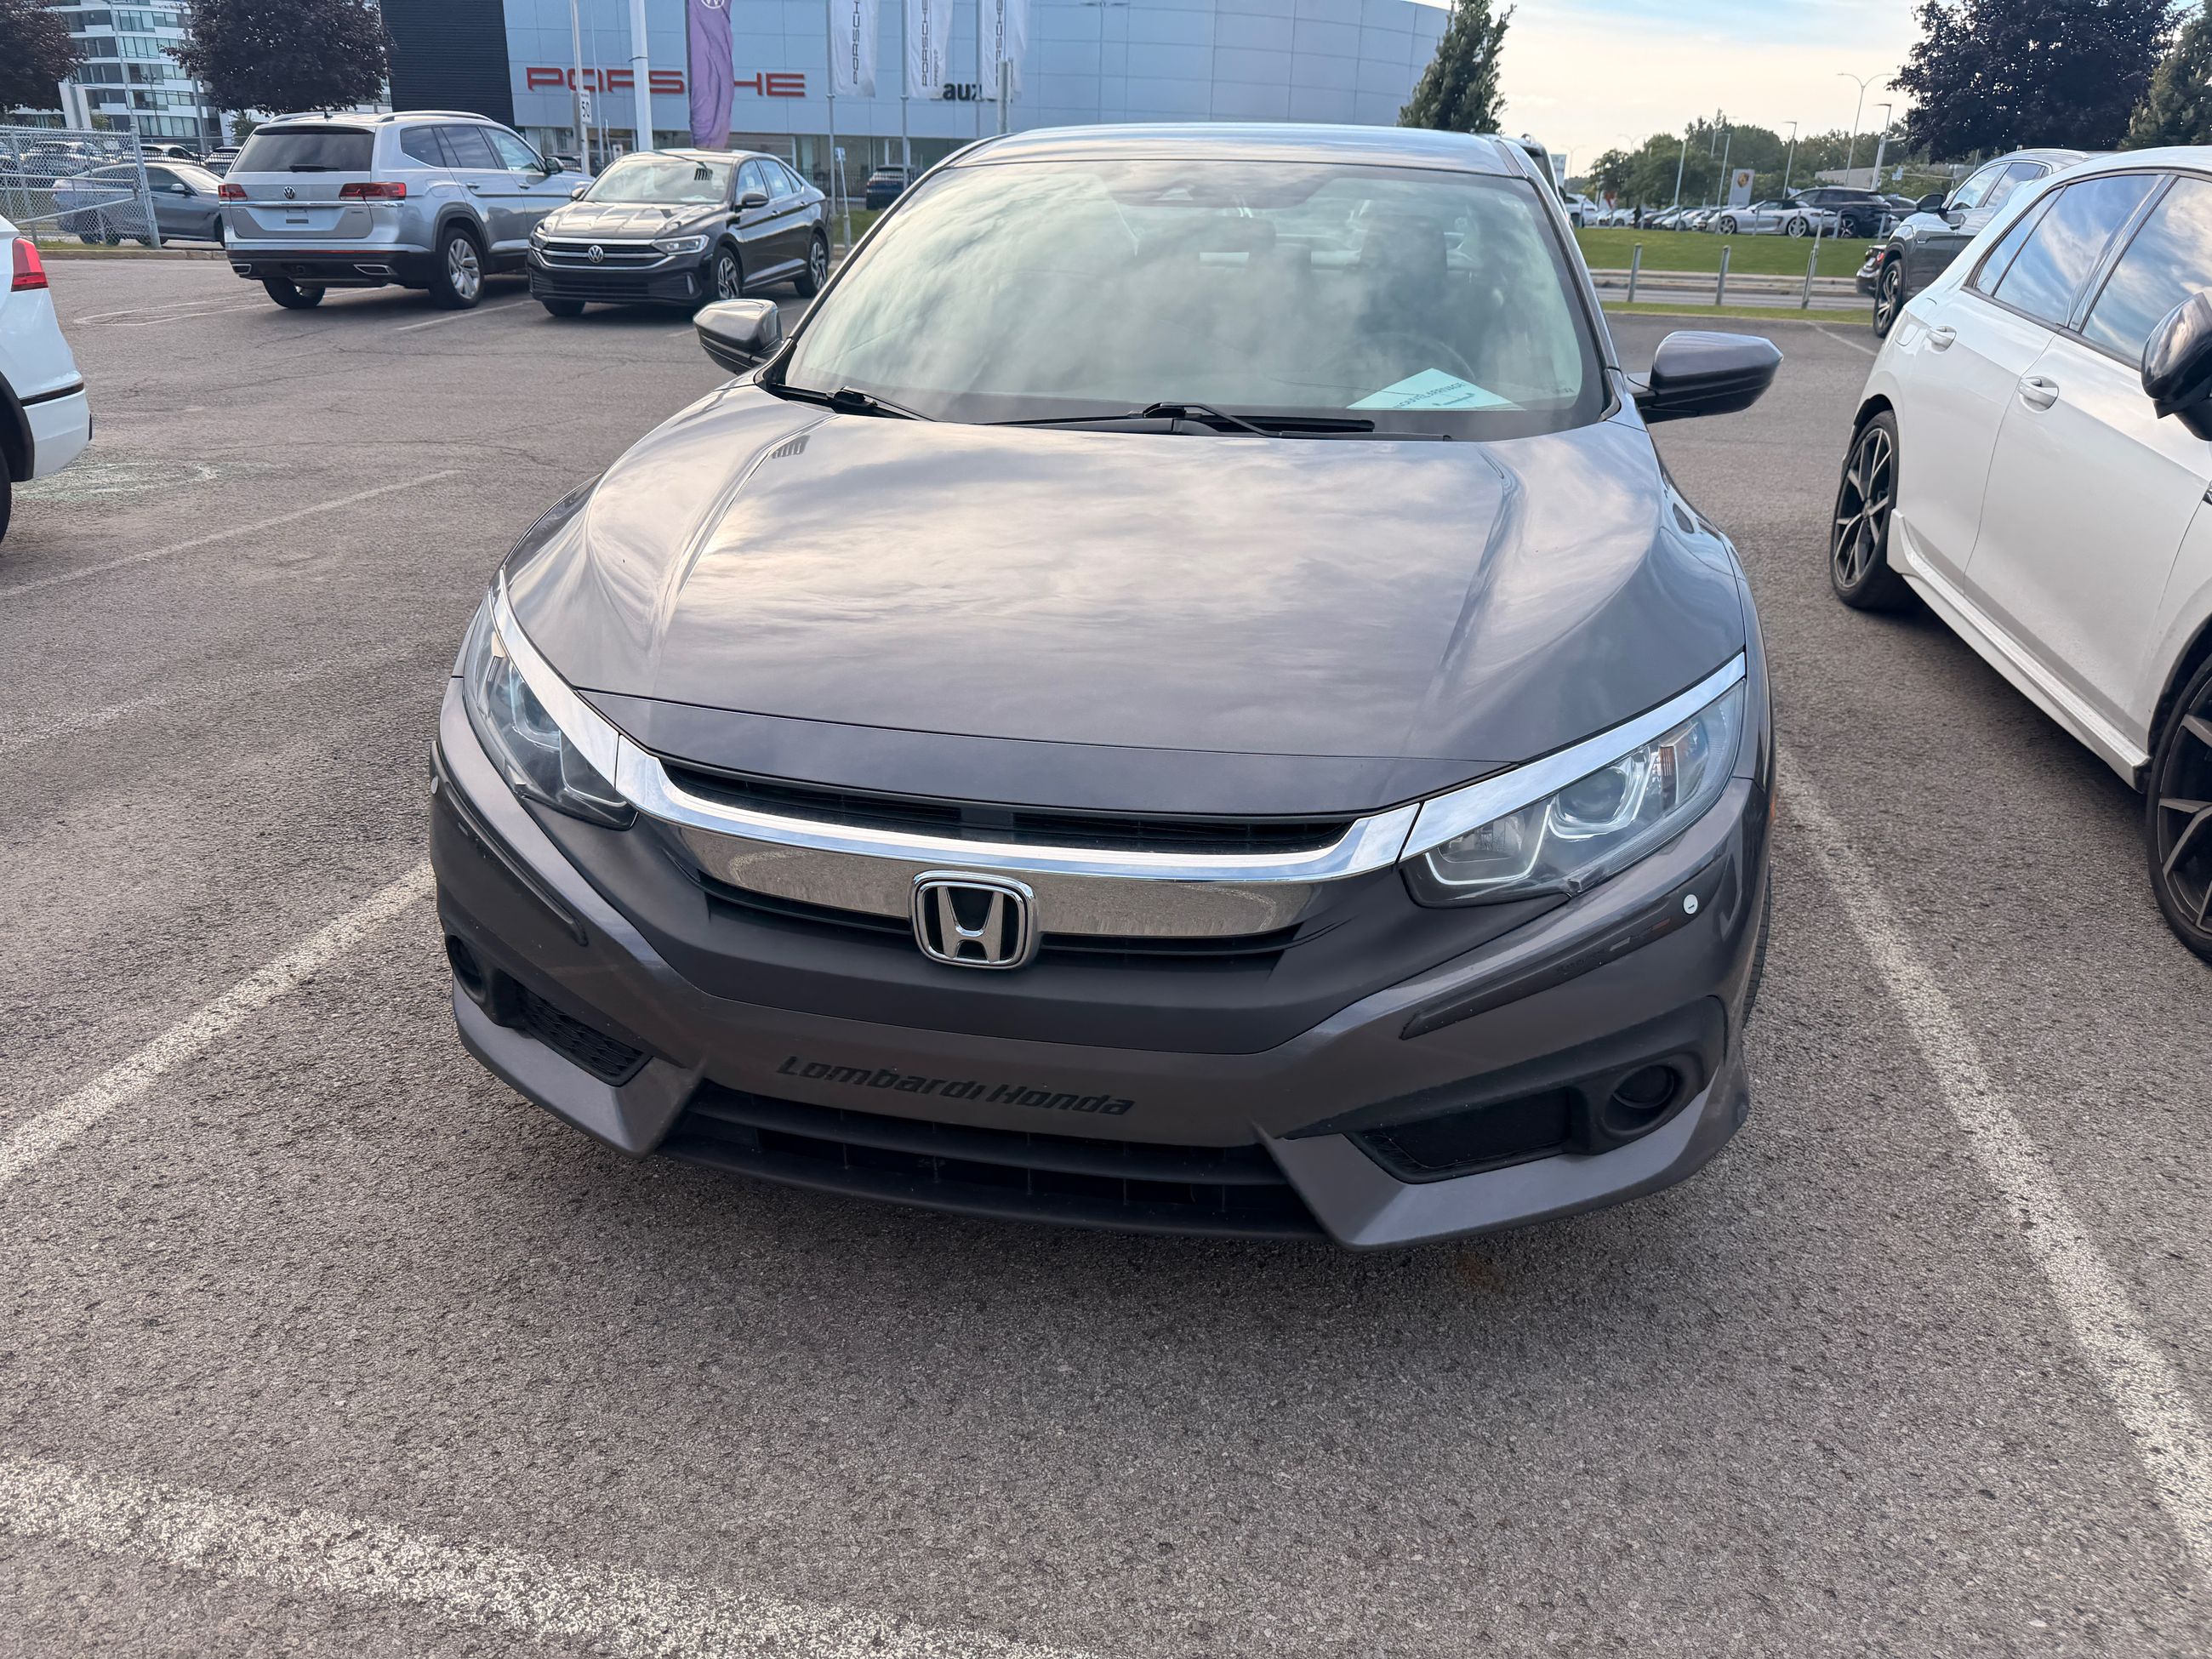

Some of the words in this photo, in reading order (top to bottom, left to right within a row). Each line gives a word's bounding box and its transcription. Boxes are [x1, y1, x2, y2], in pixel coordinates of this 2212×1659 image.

[527, 67, 805, 96] PORSHE
[581, 101, 590, 117] 50
[777, 1056, 985, 1100] Lombardi
[986, 1083, 1136, 1115] Honda
